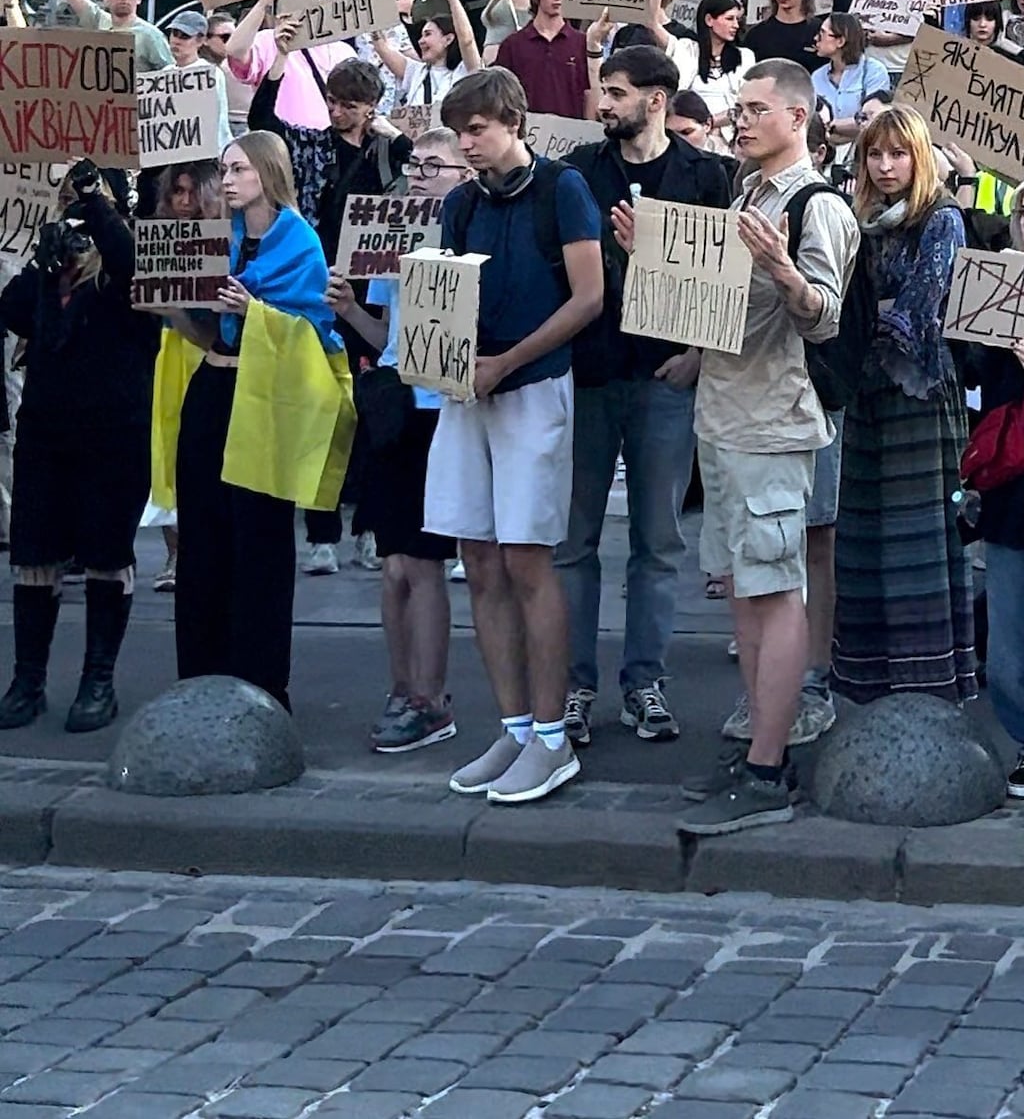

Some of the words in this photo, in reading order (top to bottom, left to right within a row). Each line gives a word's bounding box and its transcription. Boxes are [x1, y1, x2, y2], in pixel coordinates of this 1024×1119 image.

[80, 45, 135, 94] СОБІ
[941, 41, 980, 73] ЯКІ
[137, 240, 170, 257] МЕНІ
[138, 221, 202, 241] НАХІБА
[358, 232, 425, 254] НОМЕР
[663, 207, 727, 273] 12414
[136, 259, 154, 274] ЩО
[156, 257, 203, 273] ПРАЦЮЄ
[405, 261, 460, 312] 12414
[624, 264, 745, 351] АВТОРИТАРНИЙ
[404, 324, 471, 389] ХУЙНЯ
